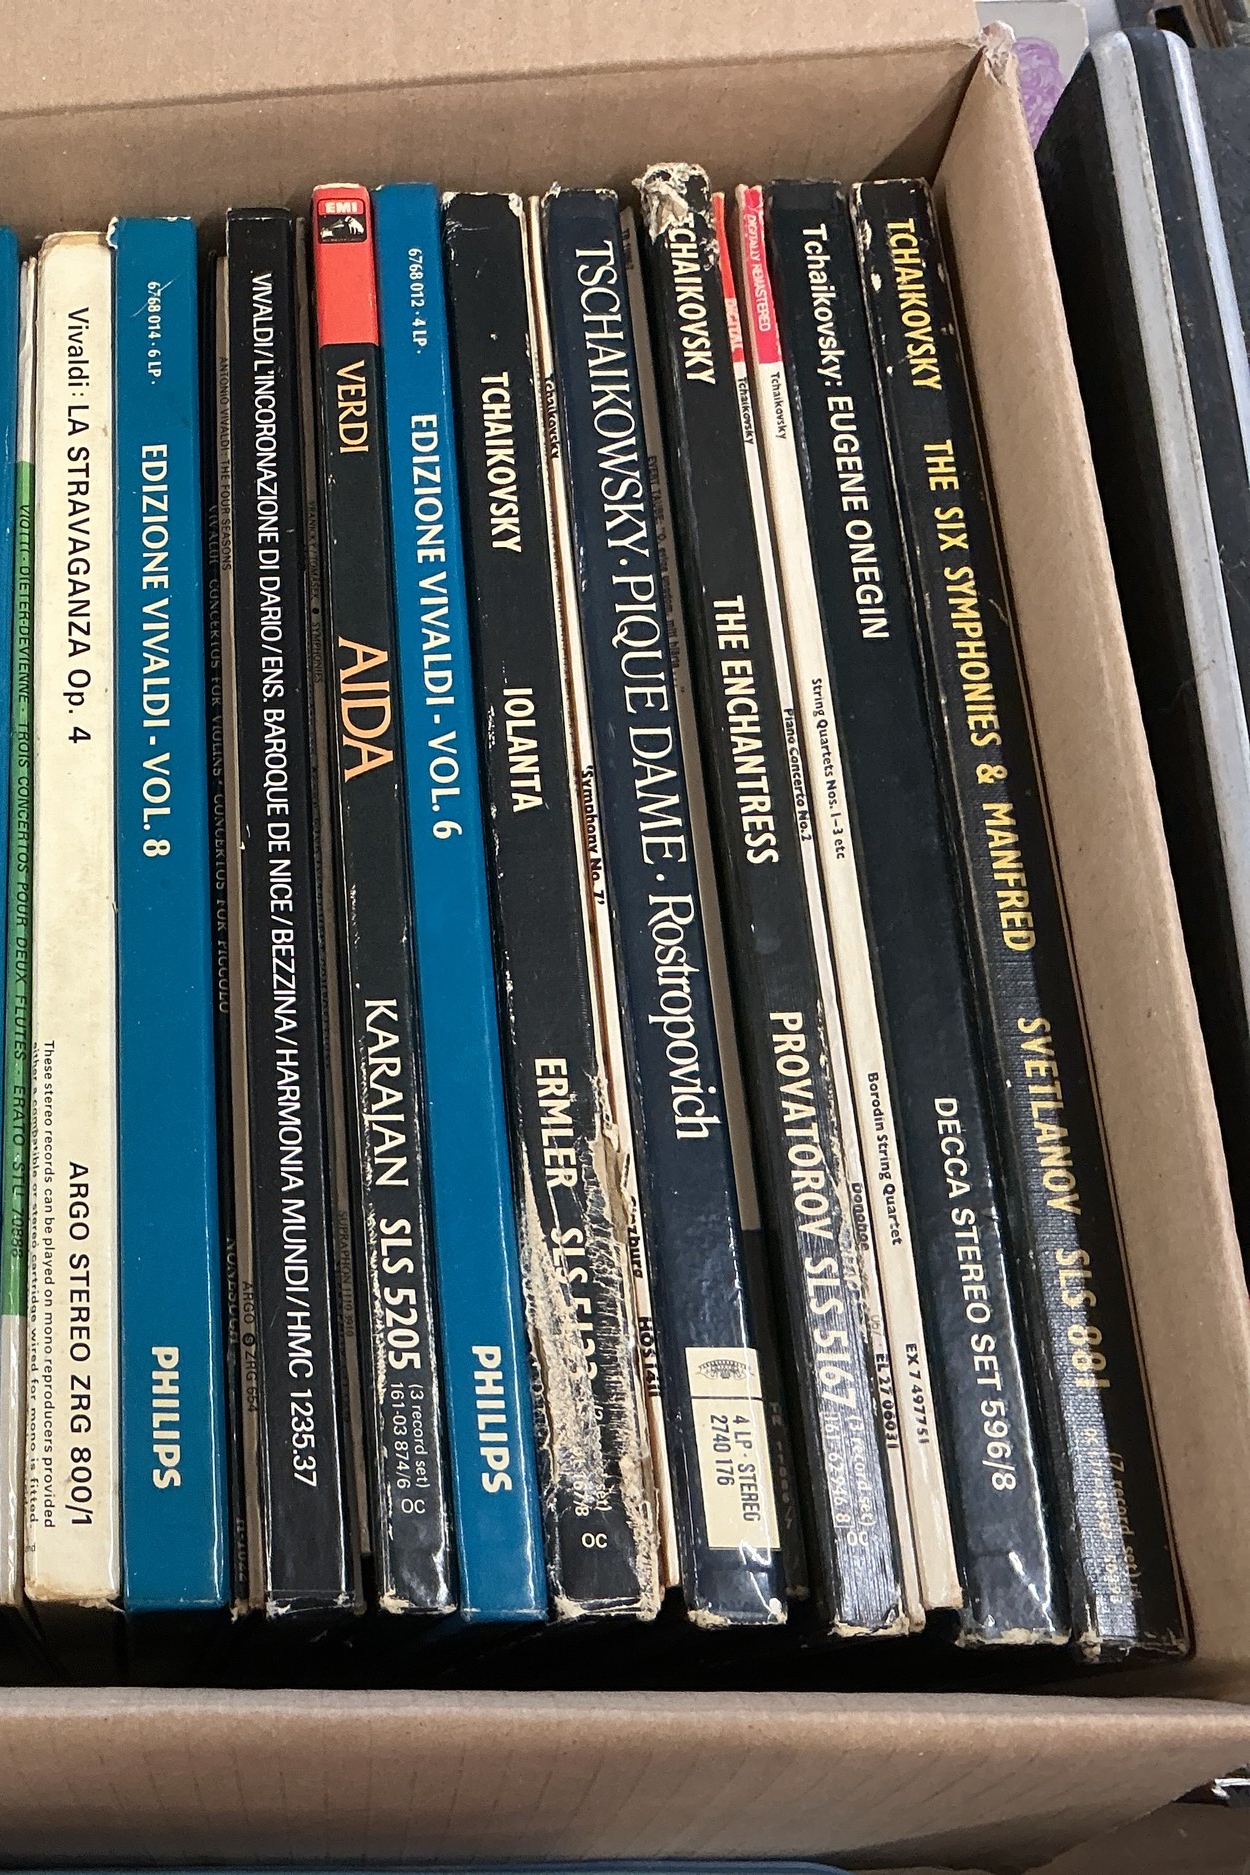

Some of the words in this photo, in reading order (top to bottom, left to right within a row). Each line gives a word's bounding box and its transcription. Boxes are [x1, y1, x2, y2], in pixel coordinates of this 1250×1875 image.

[324, 201, 358, 214] EMI
[663, 214, 718, 384] TCHAIKOVSKY
[803, 223, 844, 386] Tchaikovsky:
[888, 218, 941, 390] TCHAIKOVSKY
[67, 404, 90, 436] LA
[337, 360, 368, 453] VERDI
[577, 240, 648, 556] TSCHAIKOWSKY
[770, 371, 787, 439] Tchaikovsky
[411, 414, 445, 563] EDIZIONE
[828, 396, 868, 511] EUGENE
[924, 439, 959, 490] THE
[67, 446, 91, 658] STRAVAGANZA
[142, 444, 169, 589] EDIZIONE
[221, 518, 234, 570] SEASONS
[934, 507, 969, 550] SIX
[846, 519, 889, 639] ONEGIN
[420, 572, 454, 705] VIVALDI
[612, 575, 668, 713] PIQUE
[713, 595, 749, 649] THE
[945, 566, 1000, 746] SYMPHONIES
[63, 668, 91, 714] Op.
[142, 599, 170, 728] VIVALDI
[811, 678, 825, 716] String
[18, 722, 32, 767] TROIS
[68, 726, 91, 744] 4
[339, 636, 393, 781] AIDA
[263, 708, 289, 815] BAROQUE
[428, 732, 460, 812] VOL.
[482, 372, 521, 552] TCHAIKOVSKY
[504, 688, 542, 812] IOLANTA
[530, 1058, 582, 1187] ERMLER
[722, 660, 778, 863] ENCHANTRESS
[787, 747, 810, 807] Concerto
[816, 719, 834, 777] Quartets
[973, 764, 1009, 783] &
[17, 777, 31, 872] CONCERTOS
[142, 754, 171, 830] VOL.
[629, 727, 686, 863] DAME
[142, 839, 171, 856] 8
[267, 823, 291, 852] DE
[432, 820, 463, 838] 6
[16, 882, 30, 926] POUR
[984, 803, 1038, 950] MANFRED
[14, 937, 30, 983] DEUX
[648, 894, 718, 1139] Rostropovich
[44, 1040, 55, 1079] These
[360, 998, 408, 1186] KARAJAN
[44, 1083, 53, 1126] stereo
[768, 1012, 833, 1239] PROVATOROV
[867, 1072, 884, 1131] Borodin
[1018, 1018, 1082, 1214] SVETLANOV
[44, 1130, 55, 1182] records
[876, 1135, 892, 1179] String
[935, 1098, 970, 1197] DECCA
[44, 1188, 53, 1212] can
[69, 1161, 90, 1241] ARGO
[882, 1183, 902, 1245] Quartet
[42, 1237, 55, 1285] played
[379, 1218, 414, 1275] SLS
[951, 1207, 990, 1322] STEREO
[1054, 1248, 1099, 1307] SLS
[69, 1253, 90, 1362] STEREO
[800, 1255, 851, 1315] SLS
[44, 1312, 53, 1353] mono
[383, 1286, 421, 1369] 5205
[971, 1334, 1002, 1389] SET
[1065, 1324, 1114, 1389] 881
[43, 1358, 54, 1452] reproducers
[70, 1374, 91, 1434] ZRG
[810, 1329, 859, 1408] 5167
[149, 1346, 181, 1488] PHILIPS
[290, 1389, 317, 1485] 1235.37
[411, 1404, 428, 1454] record
[472, 1346, 512, 1492] PHILIPS
[710, 1415, 732, 1452] 2740
[734, 1431, 753, 1449] LP
[981, 1399, 1016, 1489] 596/8
[43, 1457, 56, 1527] provided
[66, 1446, 93, 1526] 800/1
[715, 1458, 735, 1485] 176
